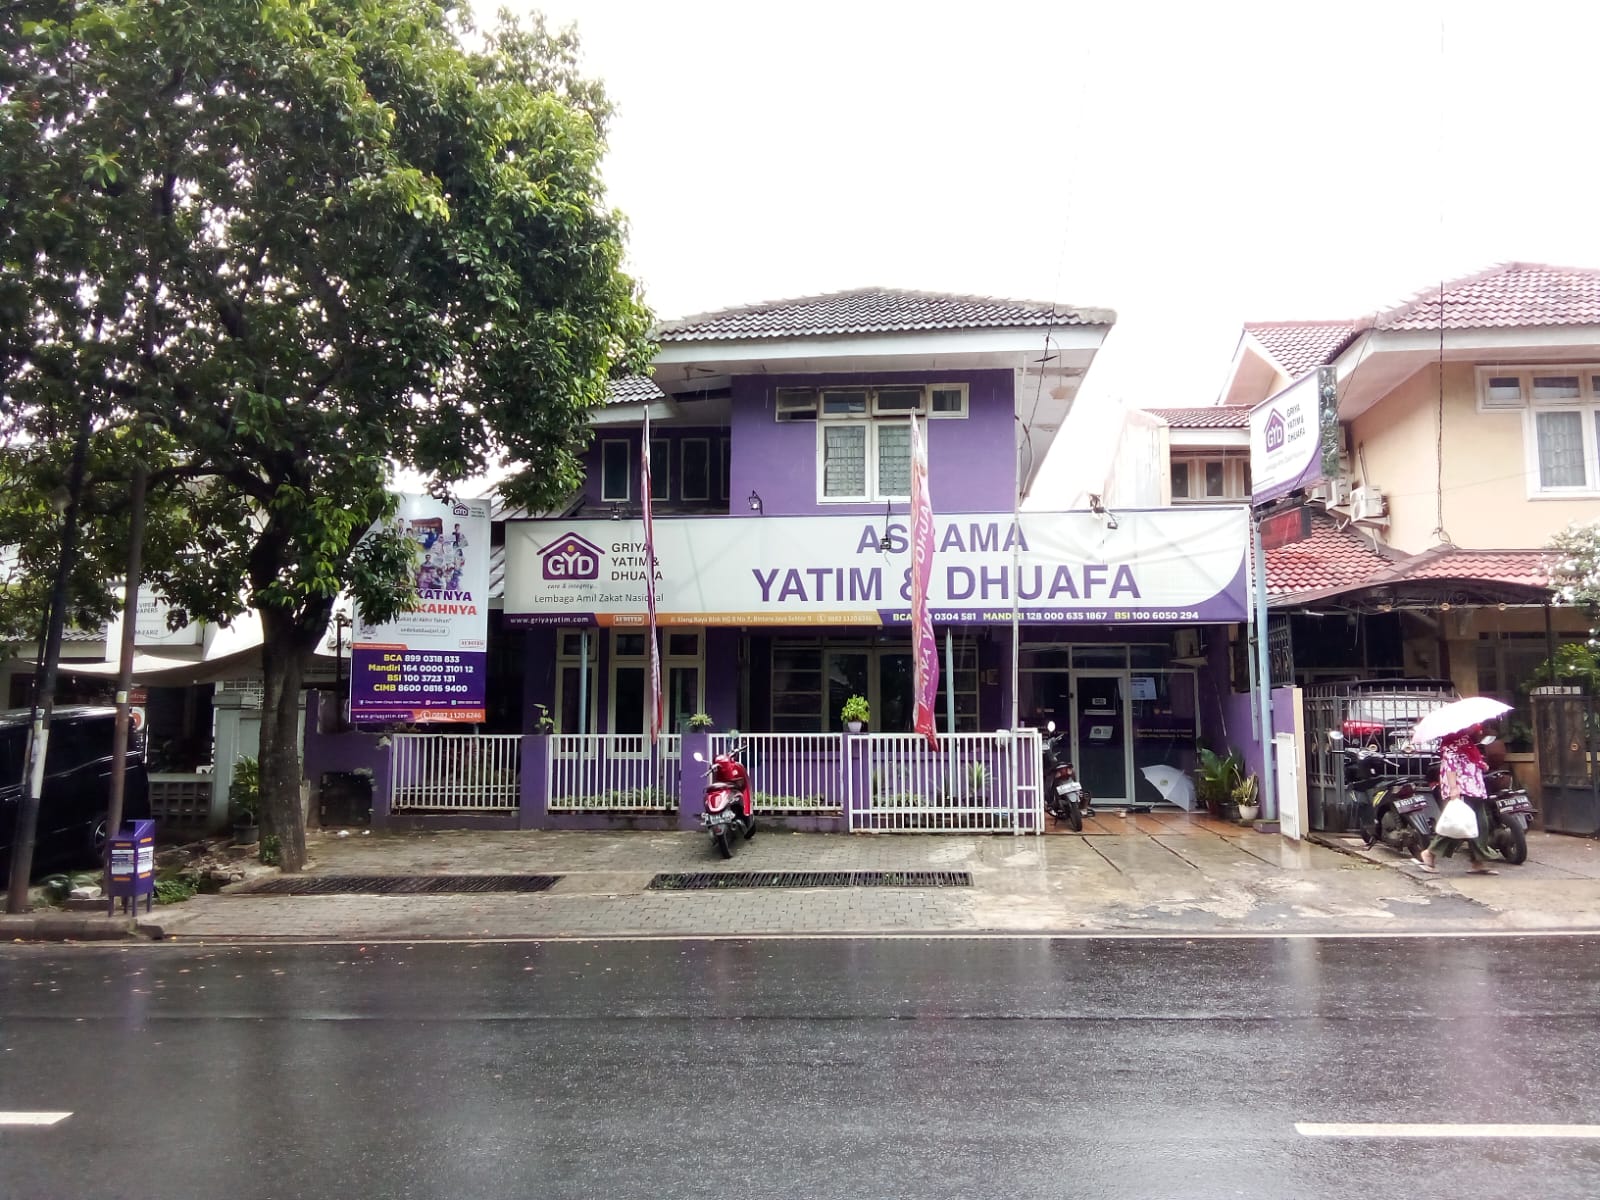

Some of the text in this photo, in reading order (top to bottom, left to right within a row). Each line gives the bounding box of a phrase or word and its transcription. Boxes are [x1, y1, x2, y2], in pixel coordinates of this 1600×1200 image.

[1268, 424, 1282, 447] GYD
[856, 523, 1030, 554] ASAMA
[548, 552, 594, 576] GYD
[611, 557, 647, 567] YATIM
[611, 571, 663, 581] DHUAA
[752, 567, 882, 602] YATIM
[946, 564, 1142, 600] DHUAFA
[534, 593, 664, 605] Lembaga Amil Zakat Nasioal
[510, 615, 589, 625] www.griyayatim.com
[893, 613, 912, 621] BCA
[934, 613, 958, 621] 0304
[961, 613, 976, 621] 581
[983, 612, 1107, 621] MANDRI 128 000 635 1867
[1114, 611, 1199, 620] BSI 100 6050 294
[384, 654, 402, 662] BCA
[423, 655, 442, 663] 0318
[444, 655, 460, 663] 833
[368, 664, 401, 672] Mandiri
[419, 665, 443, 673] 0000
[387, 674, 401, 682] BSI
[404, 674, 420, 682] 100
[443, 675, 456, 683] 131
[373, 684, 468, 693] CIMB 8600 0816 9400
